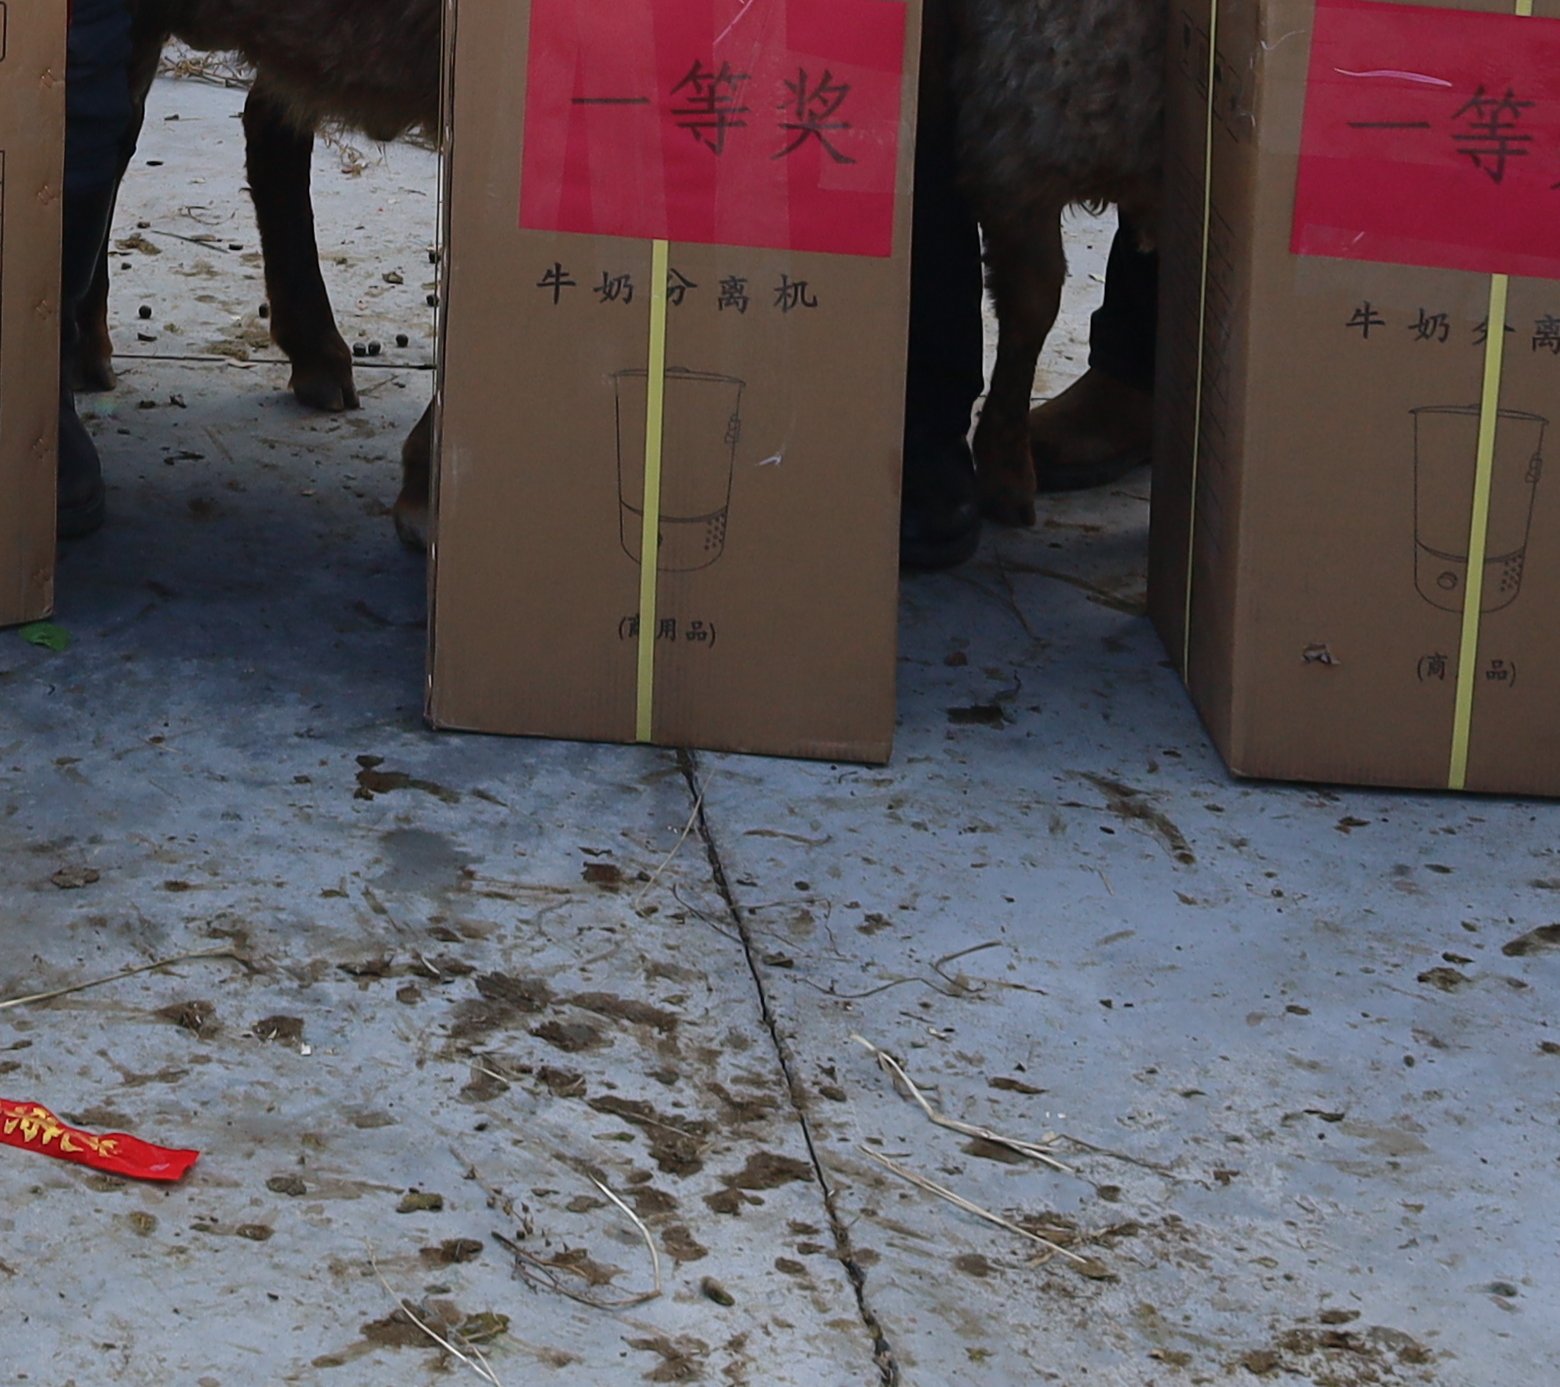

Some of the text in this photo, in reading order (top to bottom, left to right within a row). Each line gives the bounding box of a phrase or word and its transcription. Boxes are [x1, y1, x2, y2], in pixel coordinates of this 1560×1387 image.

[571, 62, 857, 165] 一等奖
[537, 262, 818, 313] 牛奶分离机
[1417, 652, 1516, 687] (商品)
